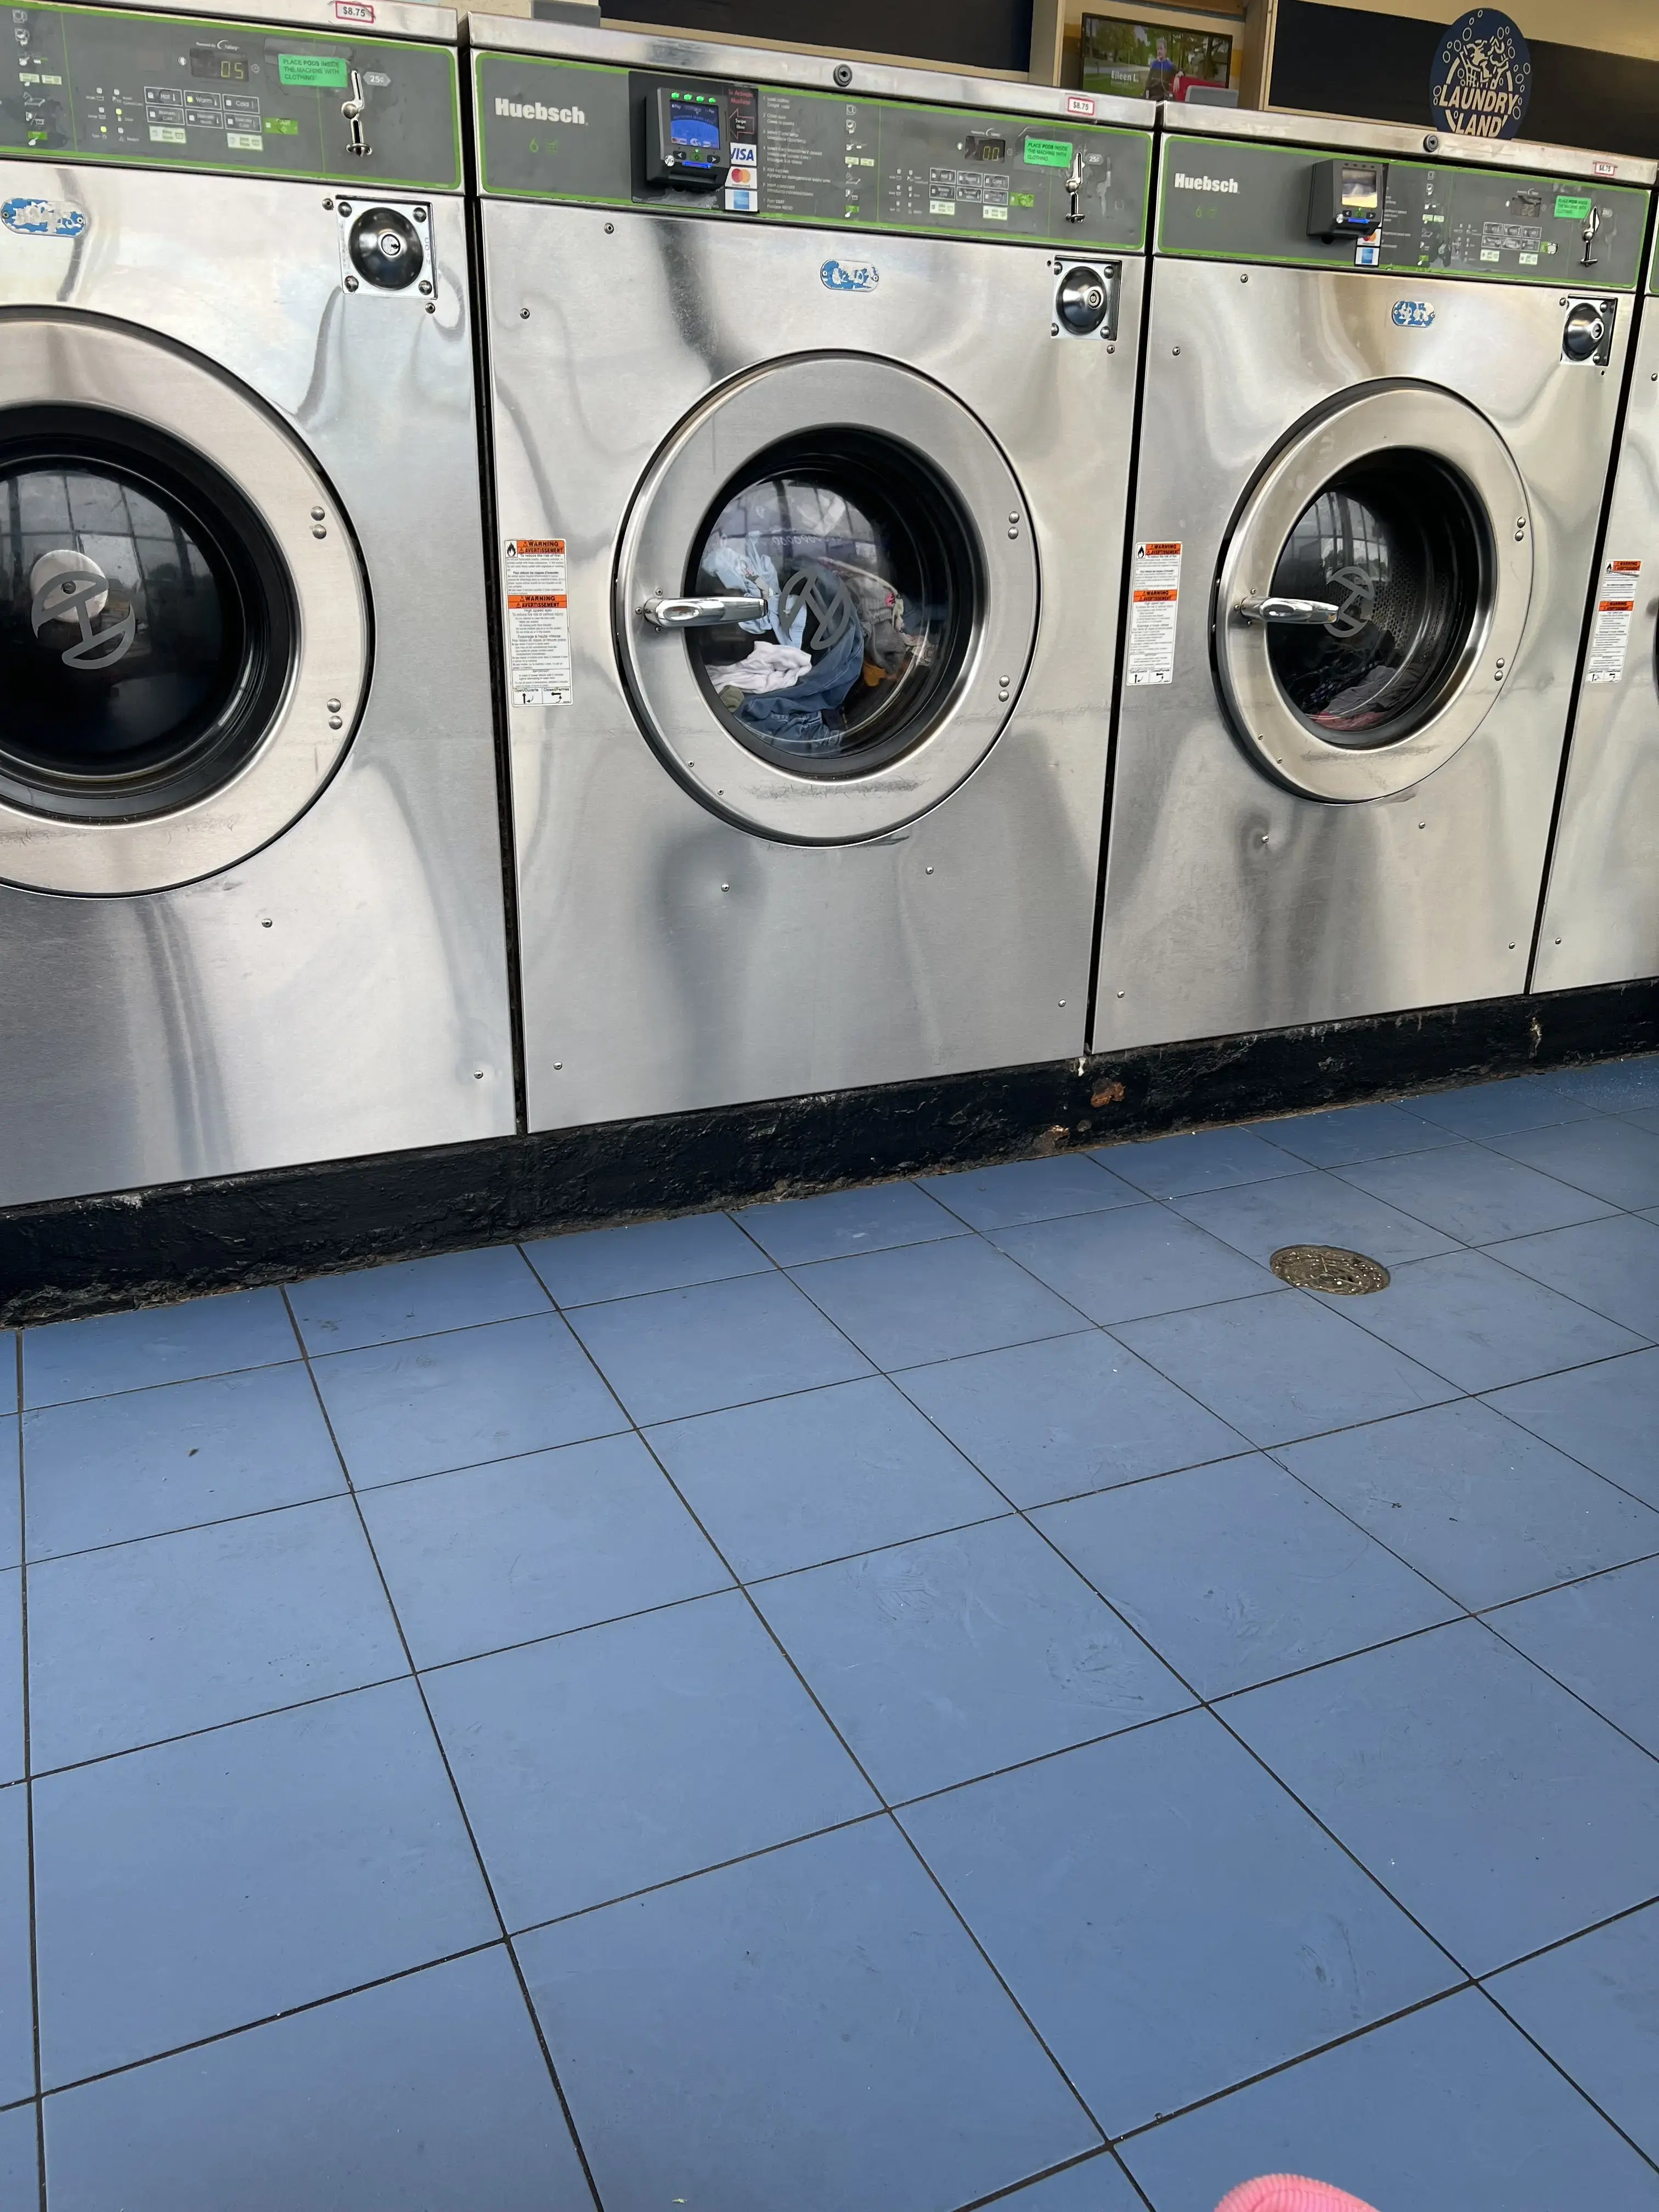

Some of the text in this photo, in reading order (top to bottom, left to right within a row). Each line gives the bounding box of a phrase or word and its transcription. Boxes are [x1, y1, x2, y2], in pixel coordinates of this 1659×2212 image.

[343, 6, 365, 17] $8.75
[221, 60, 244, 79] 05
[1111, 70, 1132, 81] Eileen
[1073, 100, 1088, 111] $8.75
[1439, 84, 1519, 115] LAUNDRY
[495, 98, 585, 125] Huebsch
[1455, 112, 1502, 137] LAND
[730, 148, 754, 161] VISA
[1174, 173, 1238, 193] Huebsch
